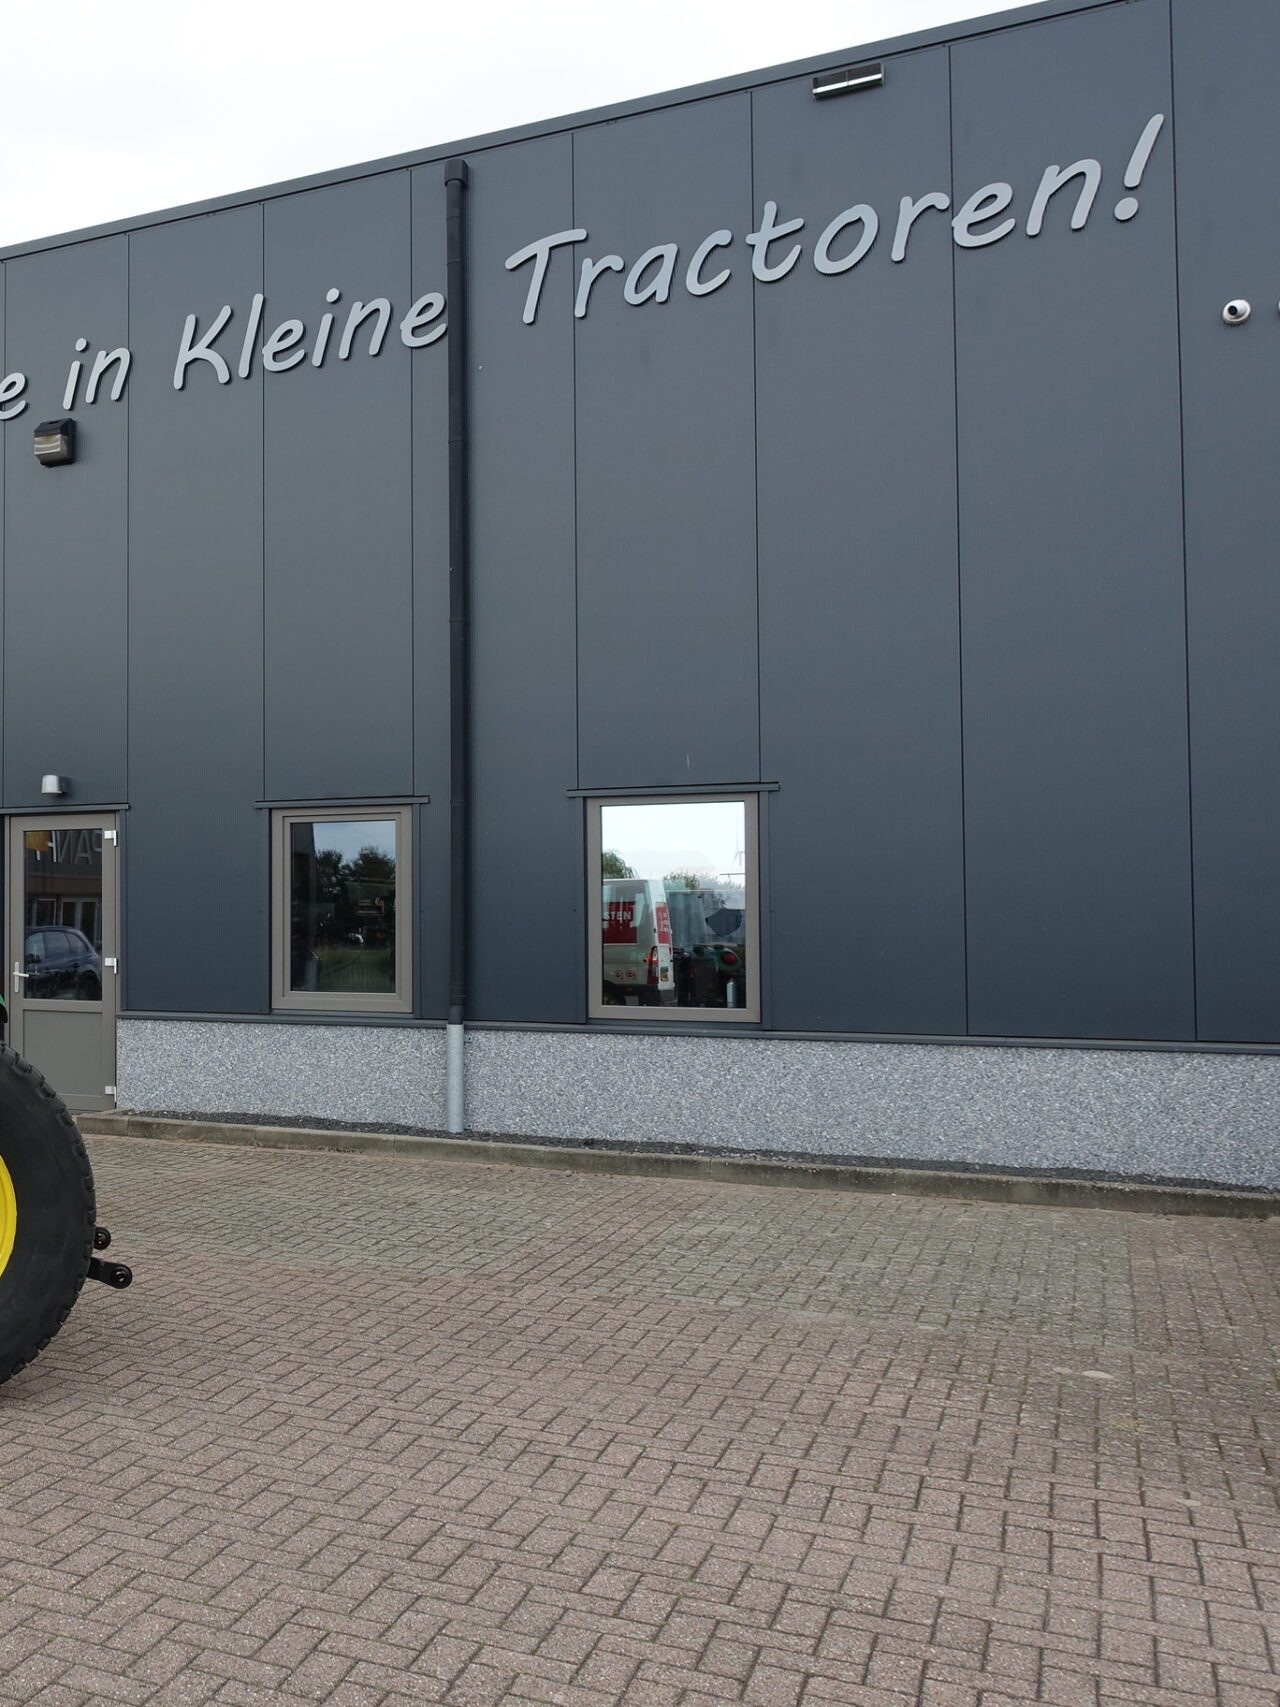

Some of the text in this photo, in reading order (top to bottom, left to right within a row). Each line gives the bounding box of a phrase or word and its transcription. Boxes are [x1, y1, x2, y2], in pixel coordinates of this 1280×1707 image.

[63, 337, 131, 410] in
[173, 287, 447, 390] Kleine
[505, 113, 1164, 323] Tractoren!
